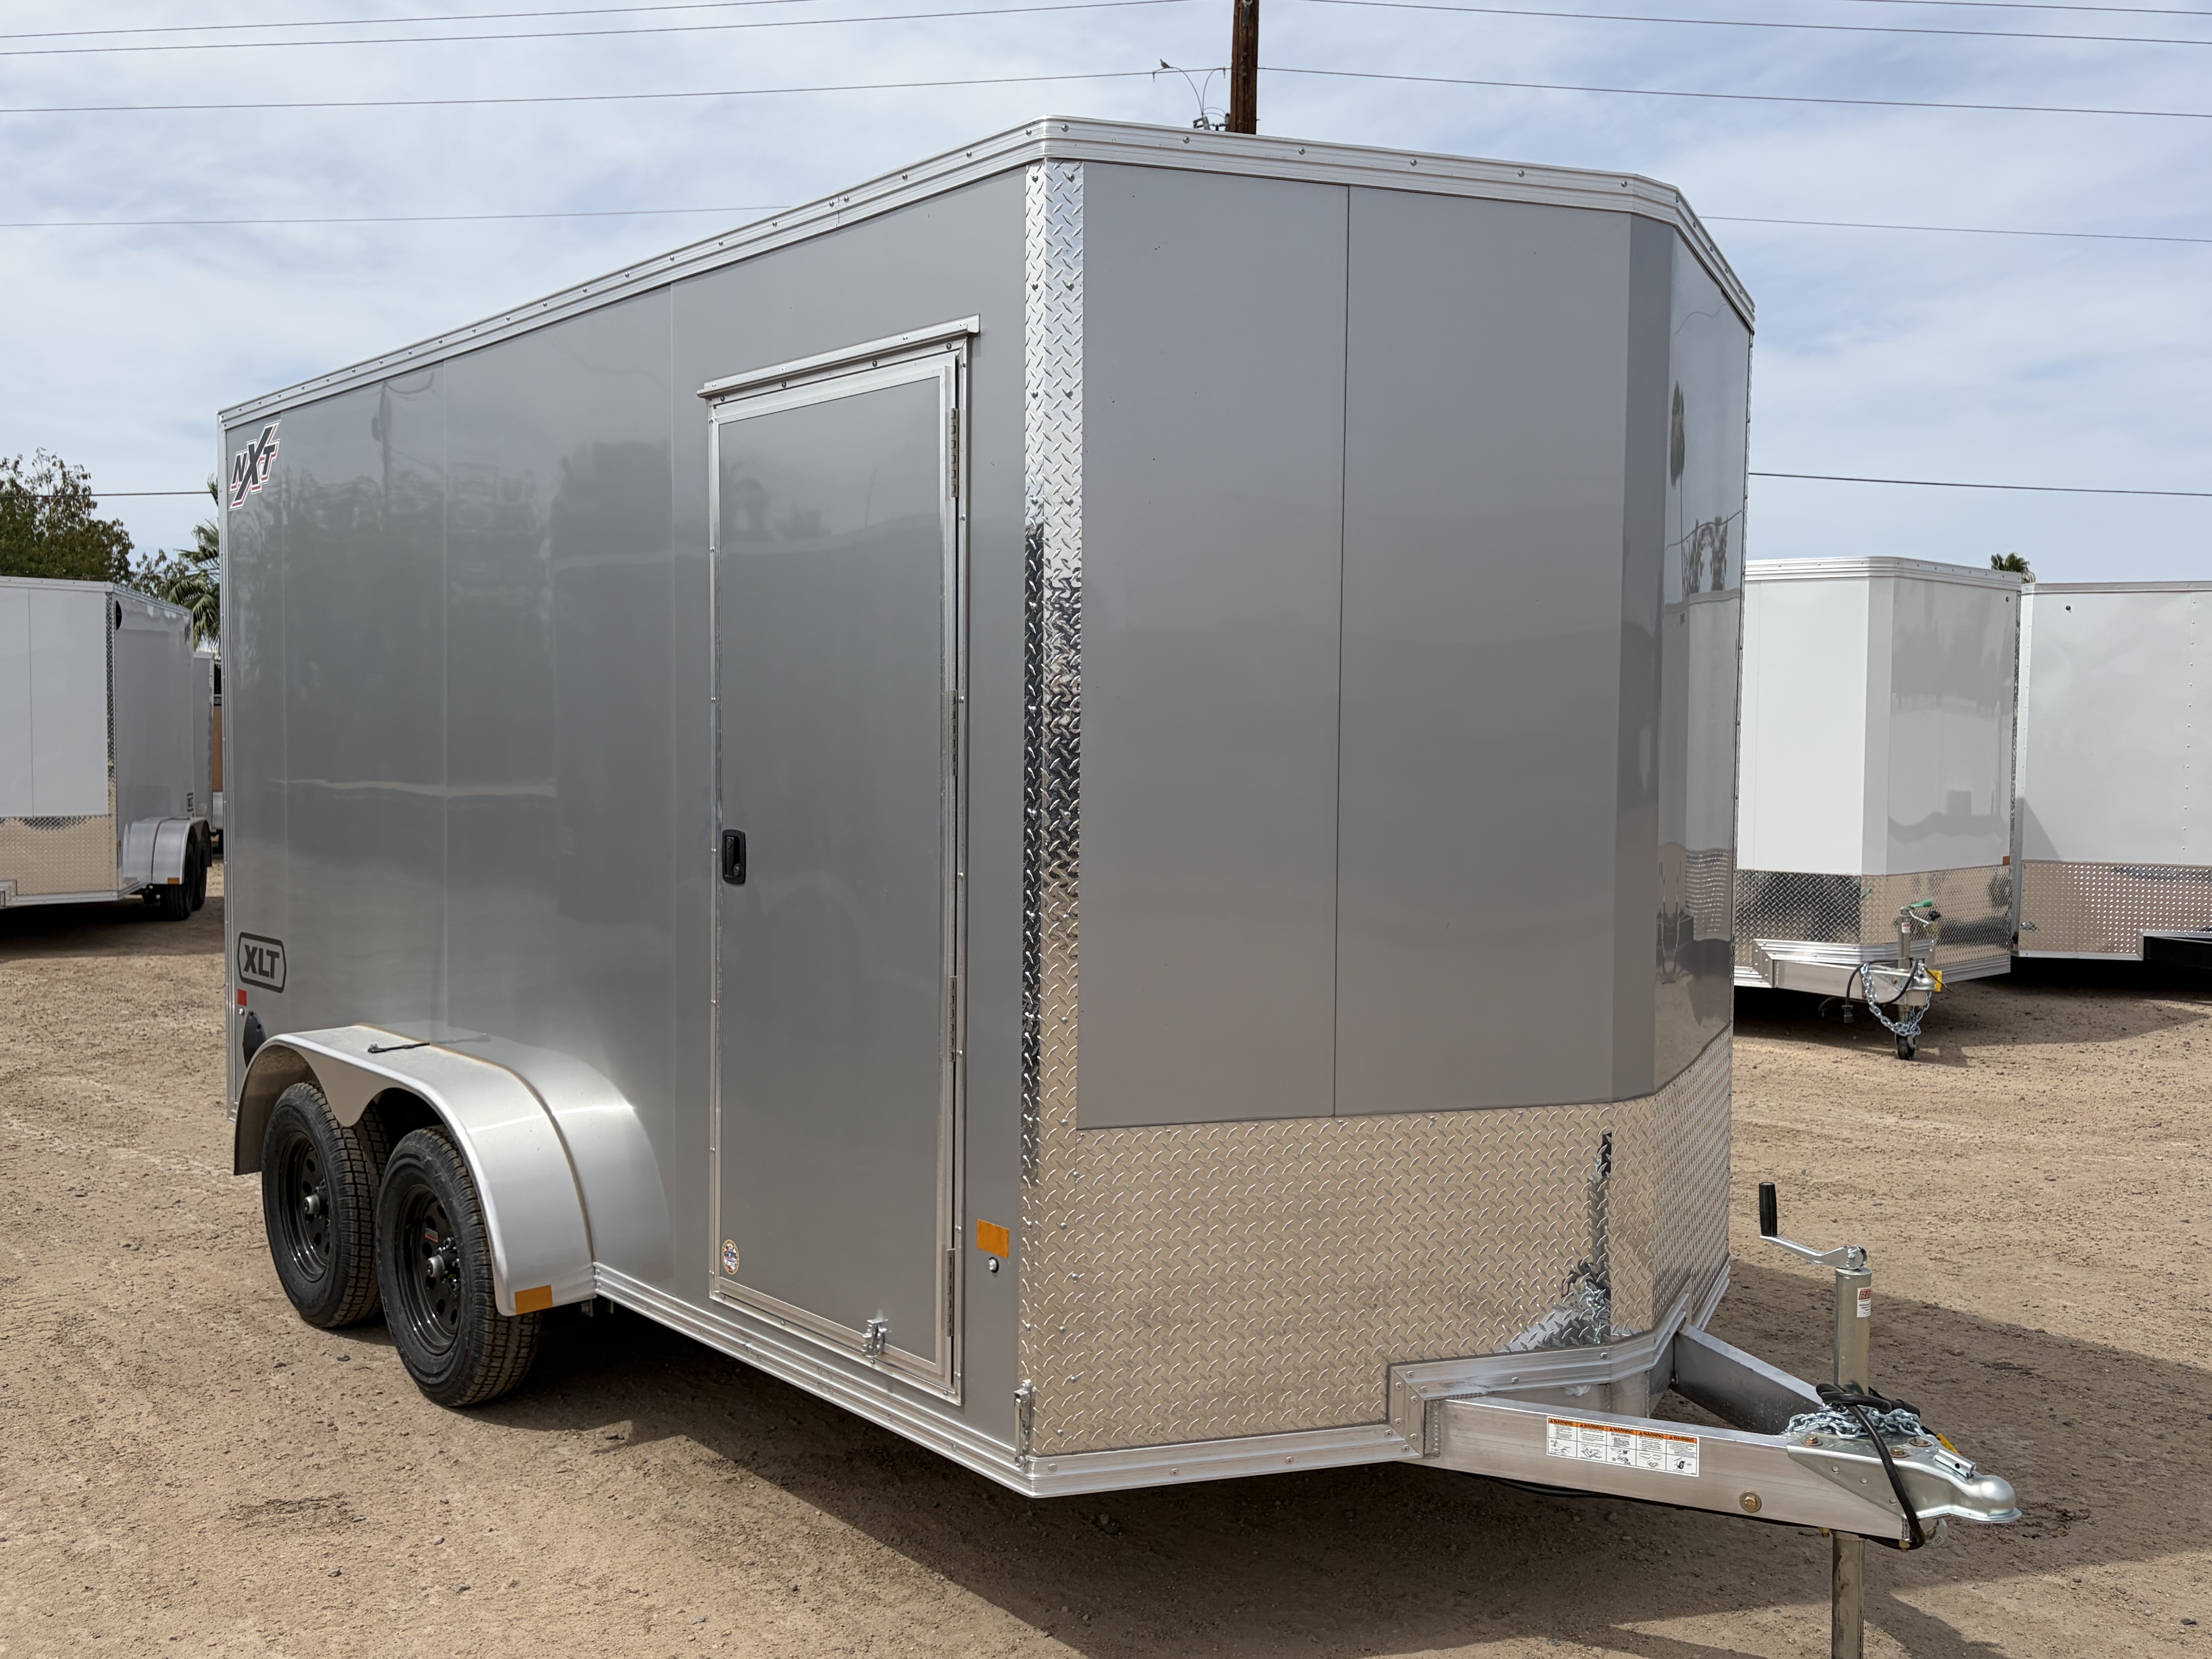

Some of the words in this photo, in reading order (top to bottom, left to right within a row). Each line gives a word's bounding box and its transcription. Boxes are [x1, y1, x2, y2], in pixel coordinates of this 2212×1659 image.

[230, 421, 281, 510] NXT
[244, 944, 280, 979] XLT
[1860, 1290, 1871, 1299] RA
